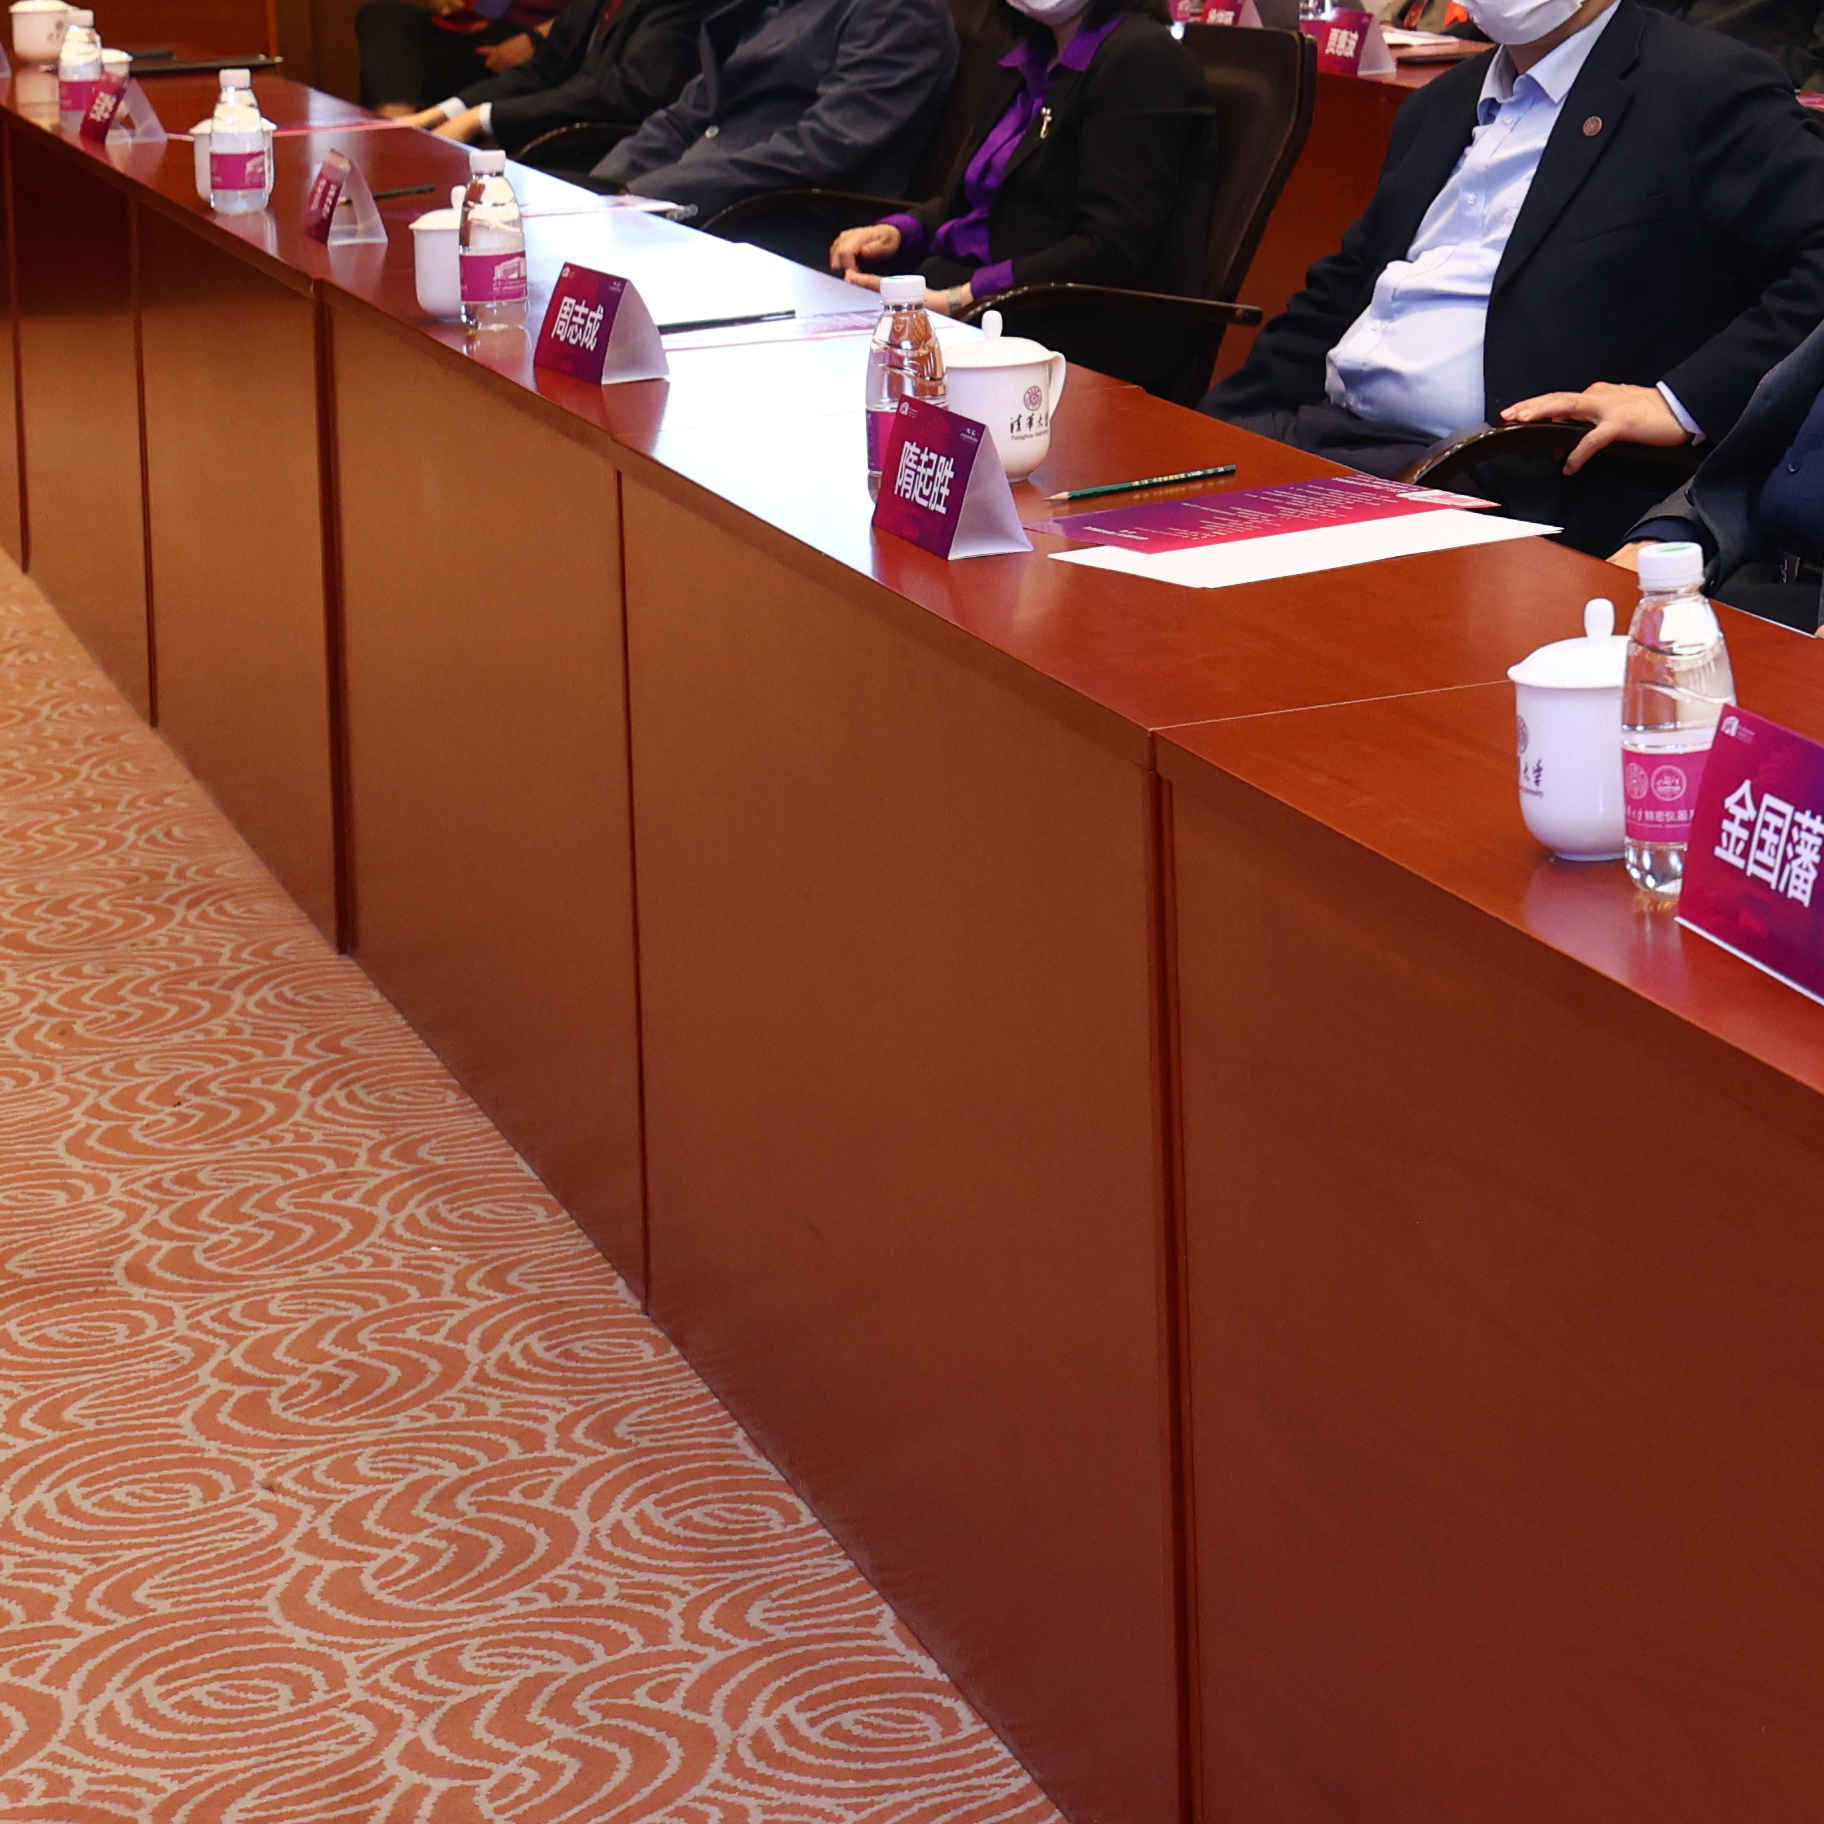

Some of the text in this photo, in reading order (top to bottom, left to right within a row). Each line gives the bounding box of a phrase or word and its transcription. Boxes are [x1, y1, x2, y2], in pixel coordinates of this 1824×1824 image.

[551, 296, 604, 352] 周志成
[894, 440, 955, 515] 隋起胜
